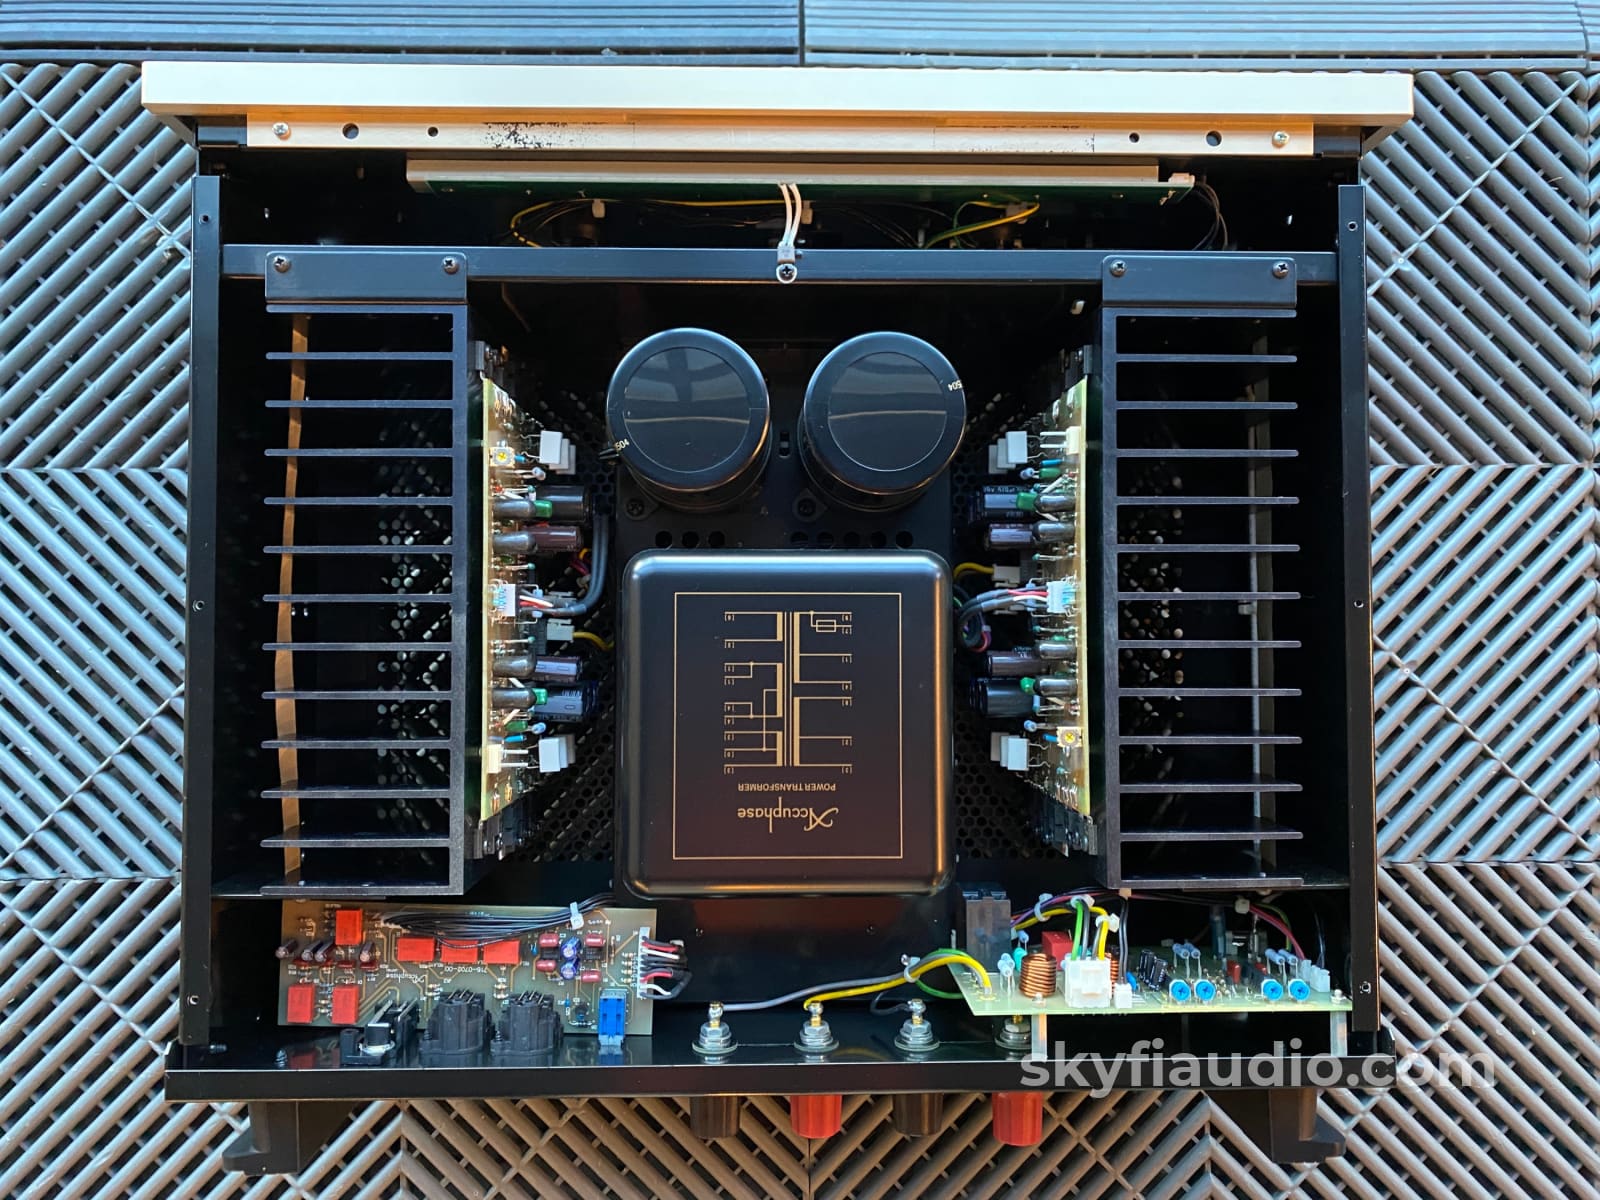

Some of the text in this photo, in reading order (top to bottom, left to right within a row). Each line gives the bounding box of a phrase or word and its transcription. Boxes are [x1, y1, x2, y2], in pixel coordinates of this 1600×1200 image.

[737, 783, 836, 791] POWER TRANSFORMER
[737, 796, 839, 833] Accuphase
